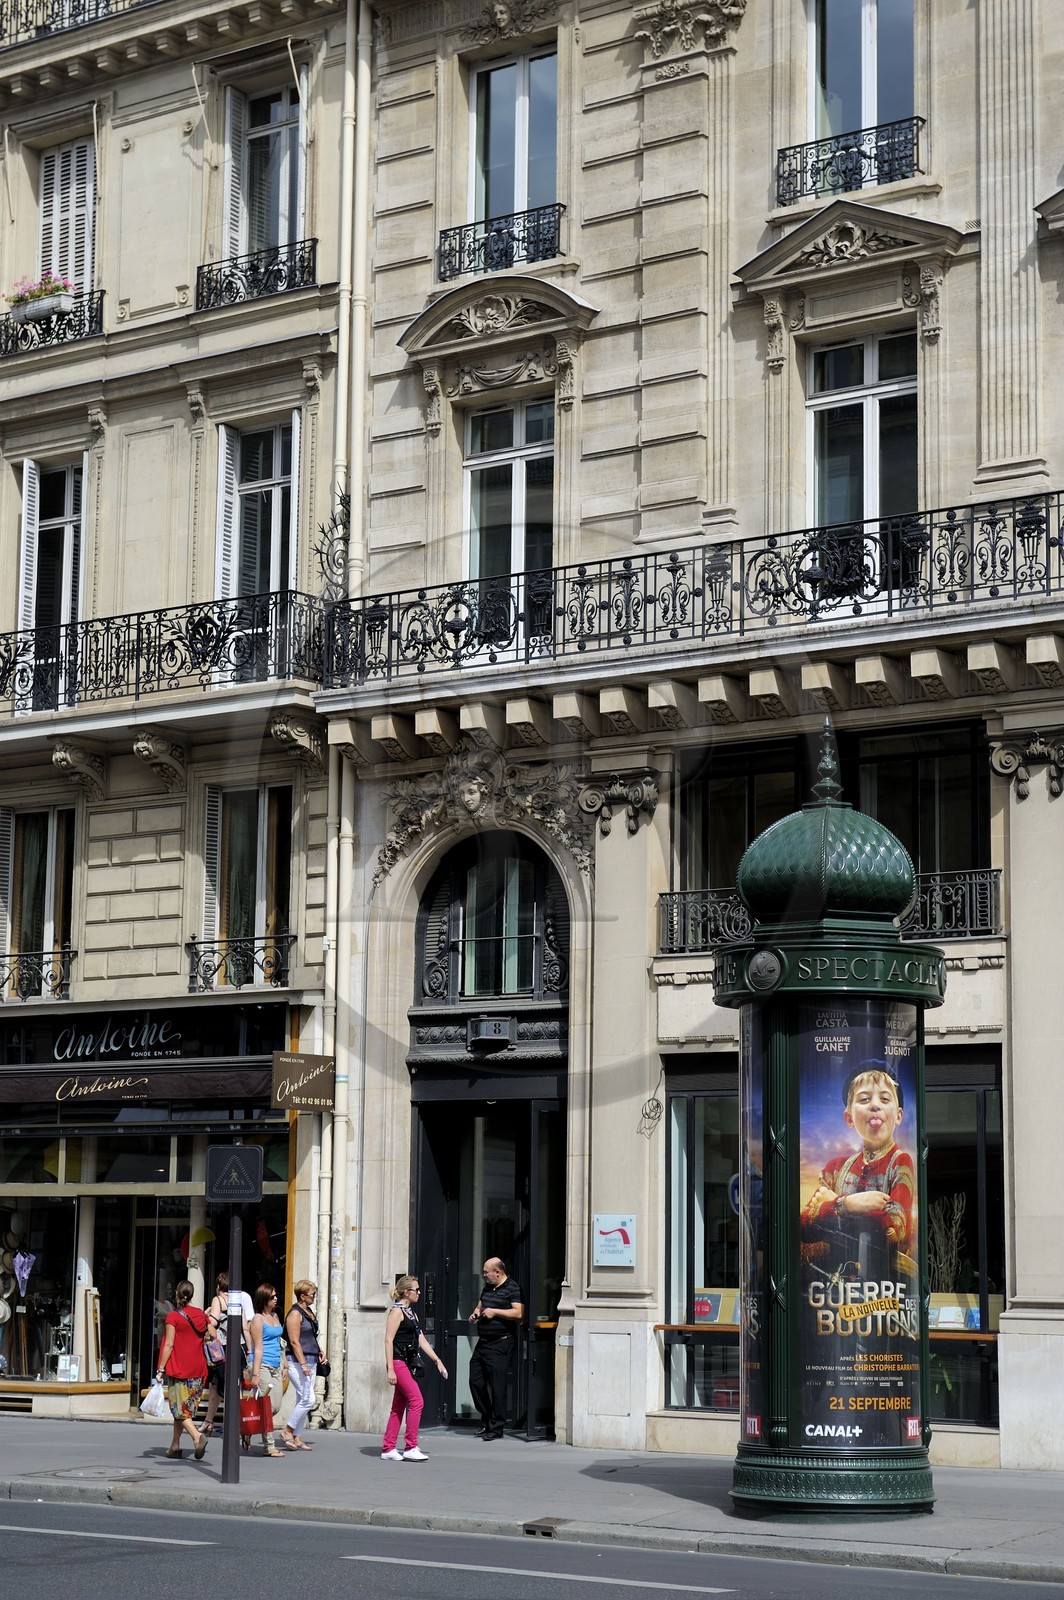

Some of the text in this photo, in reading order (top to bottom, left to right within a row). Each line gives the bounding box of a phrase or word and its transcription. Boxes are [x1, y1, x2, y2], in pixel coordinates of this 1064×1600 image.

[798, 957, 937, 986] SPECTACLE
[494, 1022, 501, 1034] 8
[815, 1019, 850, 1028] CASTA
[815, 1043, 850, 1052] CANET
[884, 1046, 911, 1057] JUGNOT
[56, 1076, 148, 1100] Antoine
[277, 1061, 334, 1102] Antoine
[808, 1281, 917, 1311] GUERRE DES
[843, 1299, 898, 1318] LA NOUVELLE
[817, 1309, 919, 1337] BOUTONS
[869, 1354, 903, 1362] CHORISTES
[853, 1363, 896, 1372] CHRISTOPHE
[829, 1397, 911, 1410] 21 SEPTEMBRE
[746, 1417, 760, 1434] RTL
[805, 1424, 863, 1437] CANAL+
[908, 1419, 920, 1437] RTL
